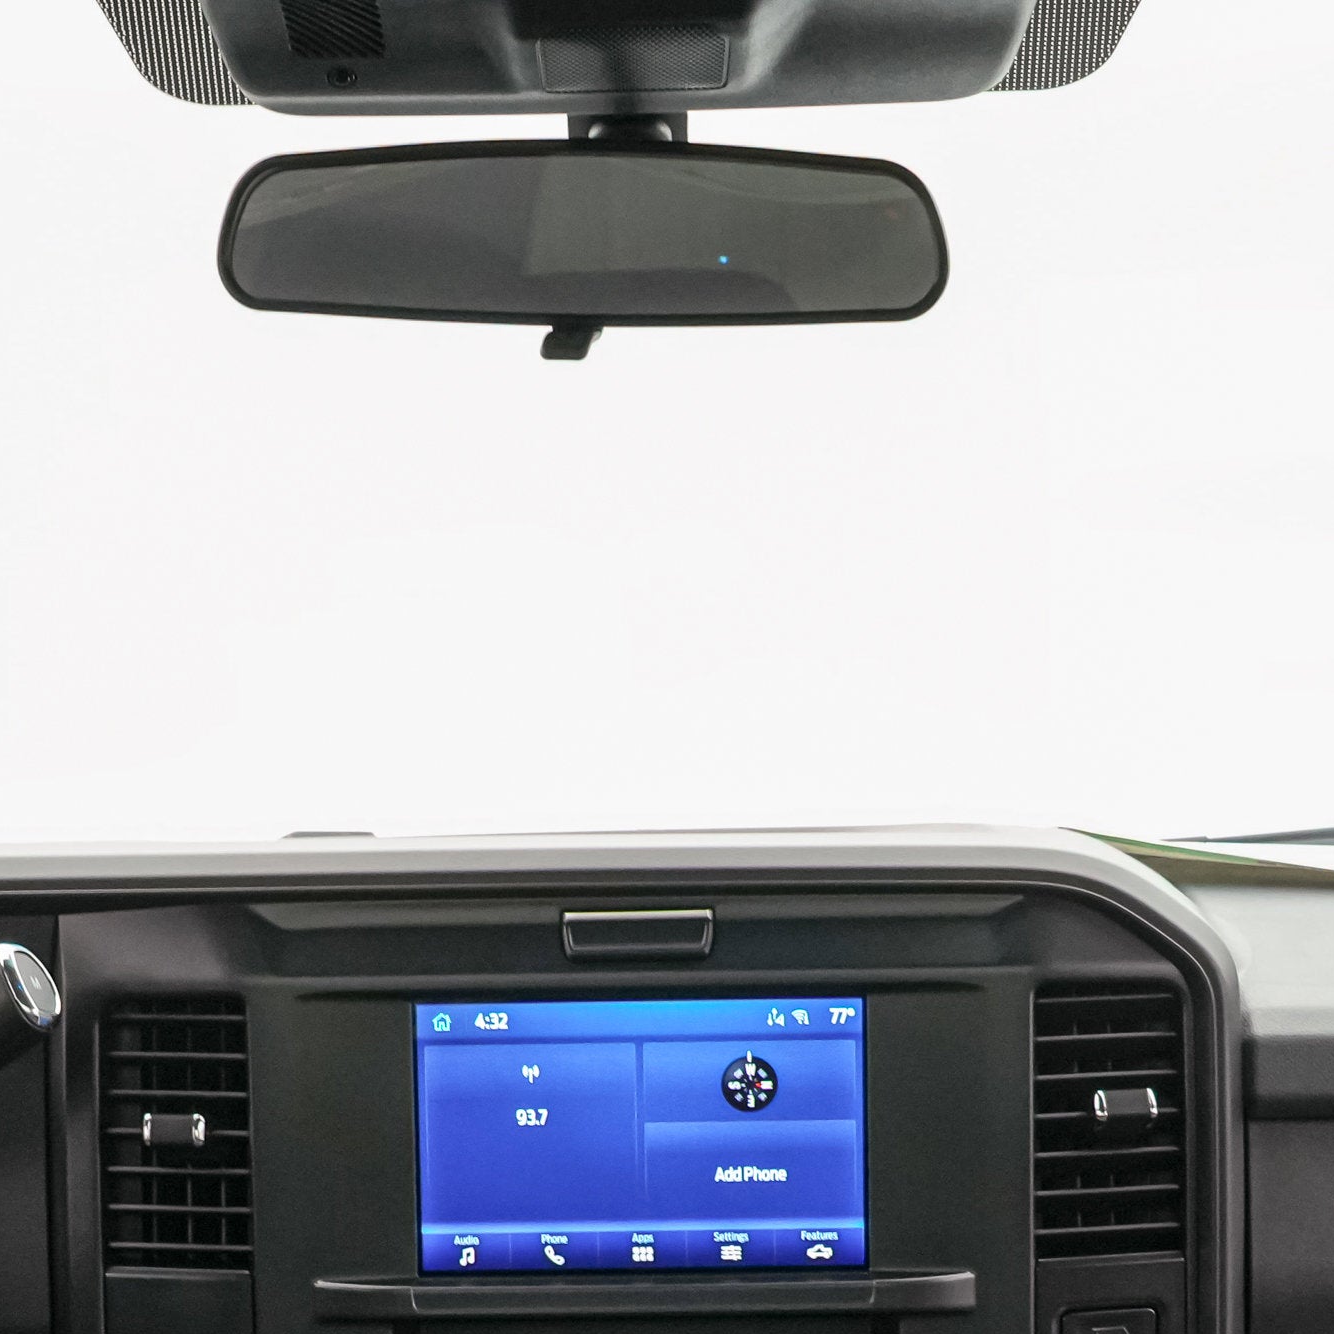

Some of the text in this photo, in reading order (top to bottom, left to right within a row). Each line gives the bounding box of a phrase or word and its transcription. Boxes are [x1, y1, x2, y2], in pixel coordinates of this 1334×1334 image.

[474, 1012, 508, 1030] 4:32
[516, 1109, 548, 1127] 93.7
[715, 1166, 787, 1182] Add Phone
[454, 1235, 479, 1245] Audio
[541, 1234, 568, 1245] Phone
[632, 1233, 654, 1244] Apps
[713, 1232, 749, 1243] Settings
[801, 1230, 839, 1240] Features
